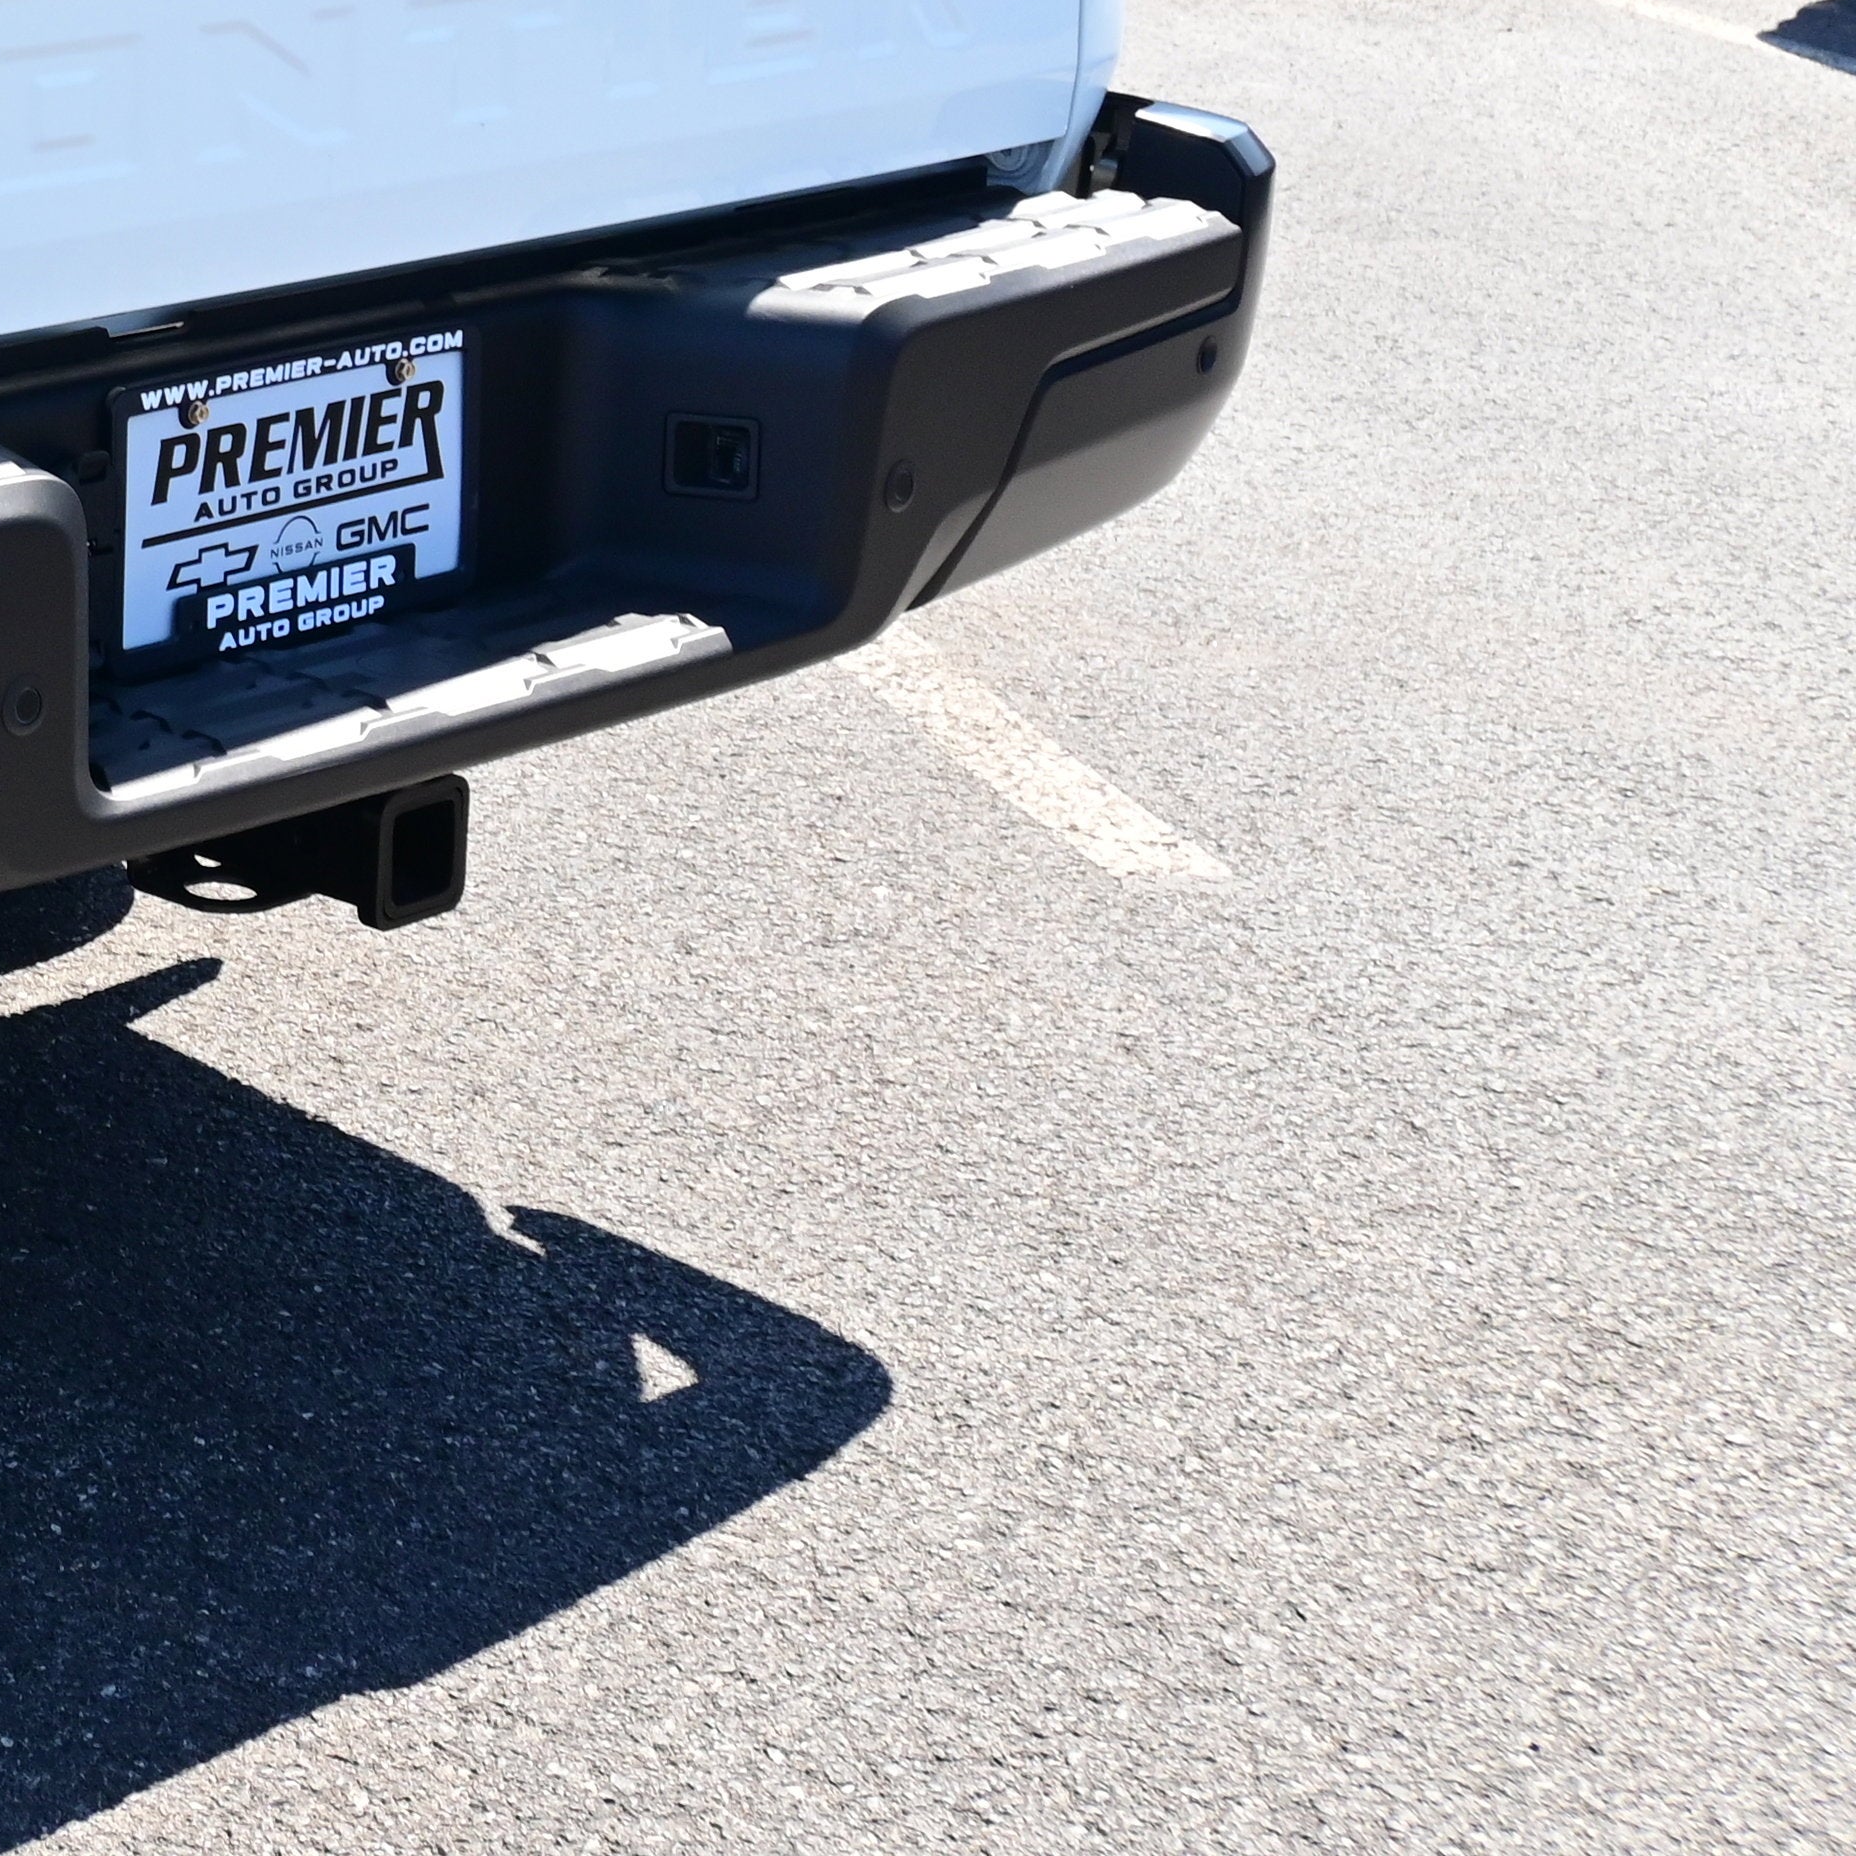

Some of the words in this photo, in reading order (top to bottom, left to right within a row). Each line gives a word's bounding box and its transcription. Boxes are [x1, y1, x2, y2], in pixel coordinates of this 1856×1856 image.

[141, 329, 464, 411] WWW.PREMIER-AUTO.COM
[150, 380, 444, 506] PREMIER
[194, 485, 281, 523] AUTO
[293, 458, 399, 500] GROUP
[270, 536, 323, 559] NISSAN
[336, 503, 430, 550] GMC
[207, 554, 397, 630] PREMIER
[219, 617, 290, 652] AUTO
[298, 594, 386, 633] GROUP
